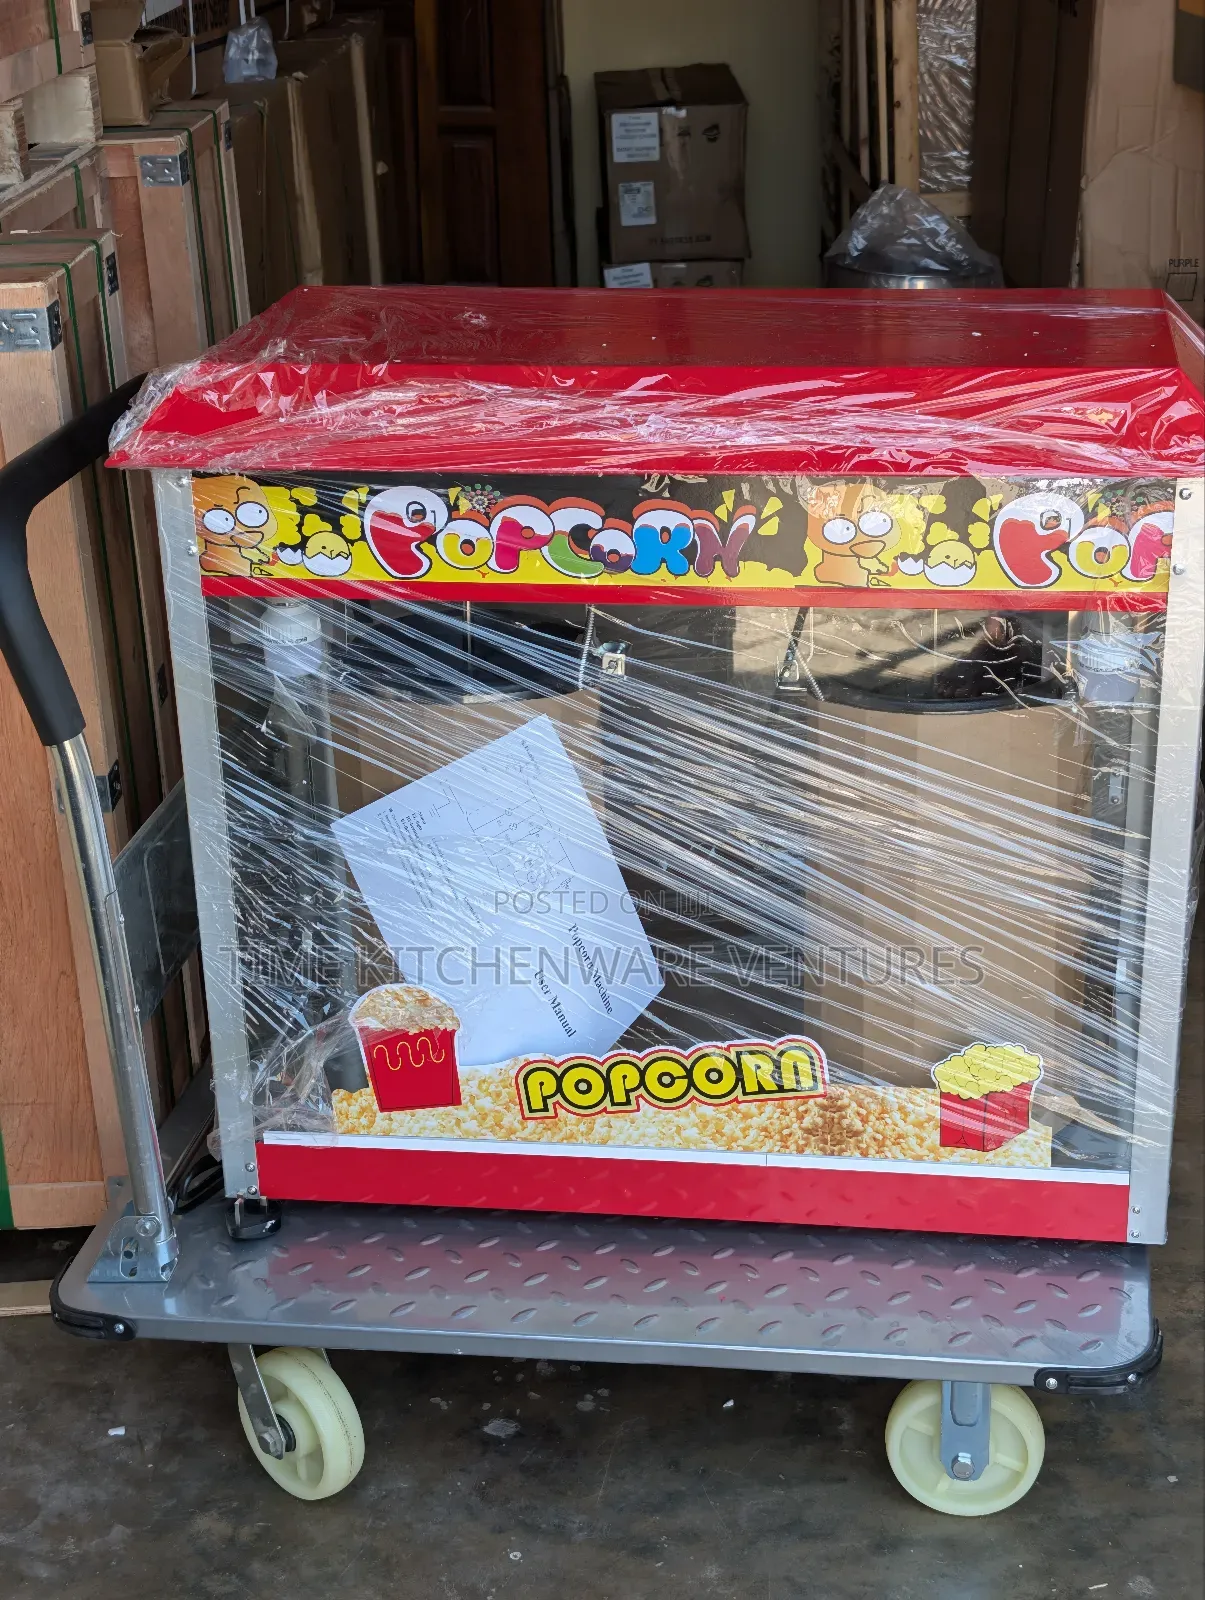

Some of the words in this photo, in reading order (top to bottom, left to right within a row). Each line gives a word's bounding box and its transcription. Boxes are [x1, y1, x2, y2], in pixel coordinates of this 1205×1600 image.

[1168, 258, 1200, 268] PURPLE
[534, 968, 552, 995] User
[548, 995, 577, 1038] Manual
[568, 923, 594, 970] Popcorn
[592, 967, 613, 1015] Machine
[521, 1044, 820, 1114] POPCORN
